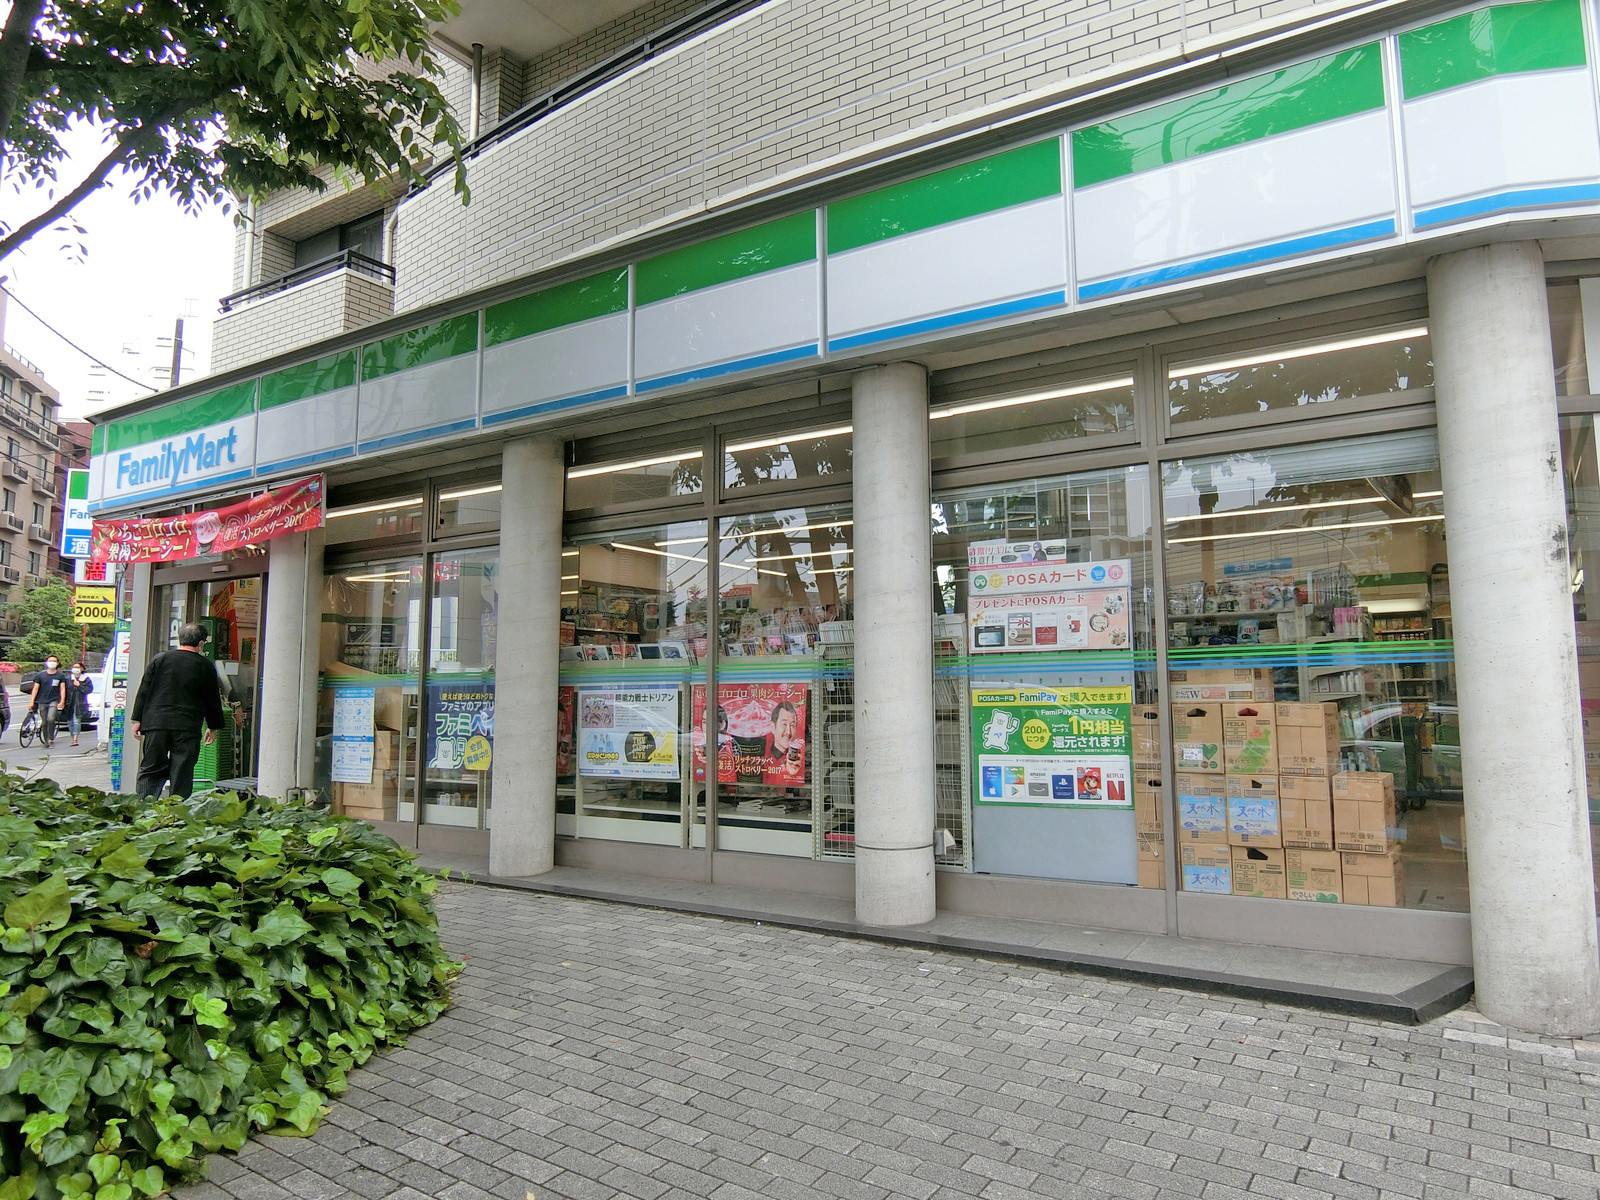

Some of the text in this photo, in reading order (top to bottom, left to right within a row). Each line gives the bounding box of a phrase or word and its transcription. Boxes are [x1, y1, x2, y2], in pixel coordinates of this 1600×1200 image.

[117, 426, 237, 489] FamilyMart
[71, 538, 90, 554] 酒
[1007, 569, 1087, 586] POSAカード
[974, 594, 1085, 609] プレゼントにPOSAカード
[75, 606, 114, 618] 2000円
[1019, 692, 1058, 703] FamiPay
[1061, 691, 1127, 702] で購入できます!
[441, 701, 495, 712] ファミマのアプリ
[1041, 707, 1113, 716] FamiPayで購入すると
[1024, 726, 1048, 734] 200円
[1069, 715, 1125, 735] 1円相当
[1026, 735, 1046, 743] につき
[1053, 735, 1126, 748] 還元されます!
[735, 755, 774, 764] リッチフラッペ
